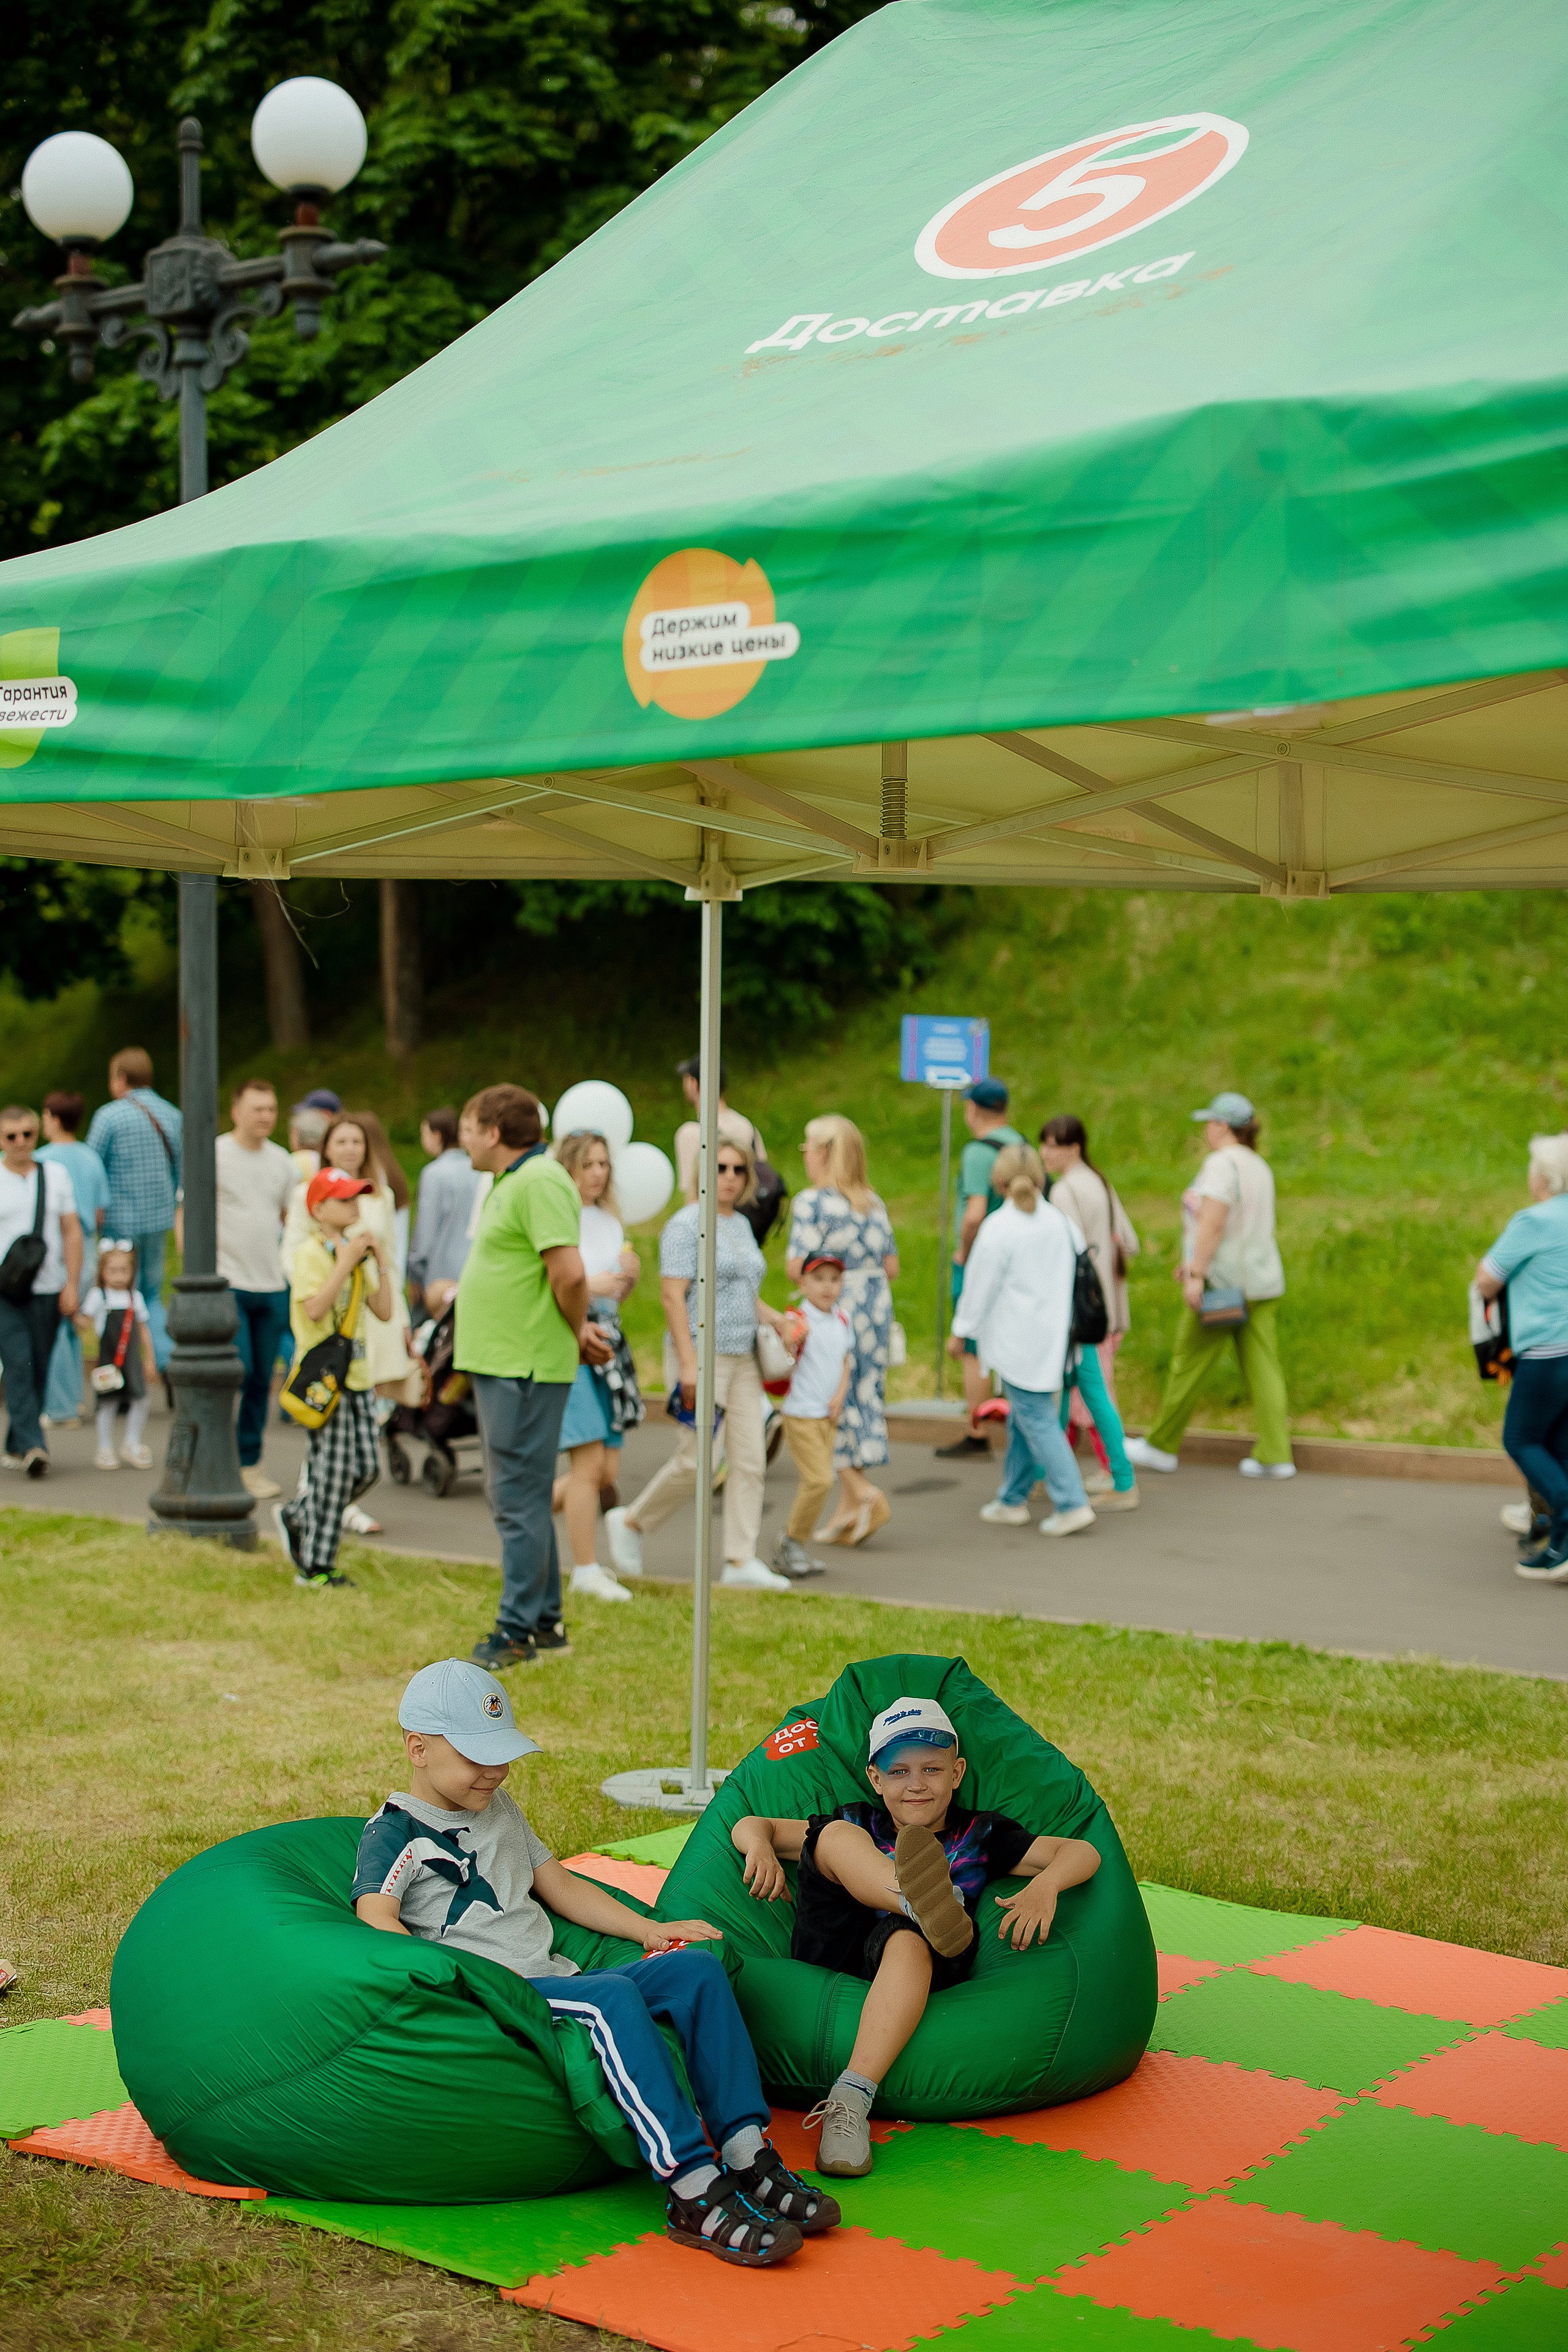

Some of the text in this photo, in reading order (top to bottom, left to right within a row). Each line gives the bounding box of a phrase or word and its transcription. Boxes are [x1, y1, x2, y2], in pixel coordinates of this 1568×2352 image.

[987, 160, 1150, 249] 5
[744, 251, 1196, 354] Доставка
[651, 612, 738, 638] Держим
[652, 634, 786, 661] низкие цены
